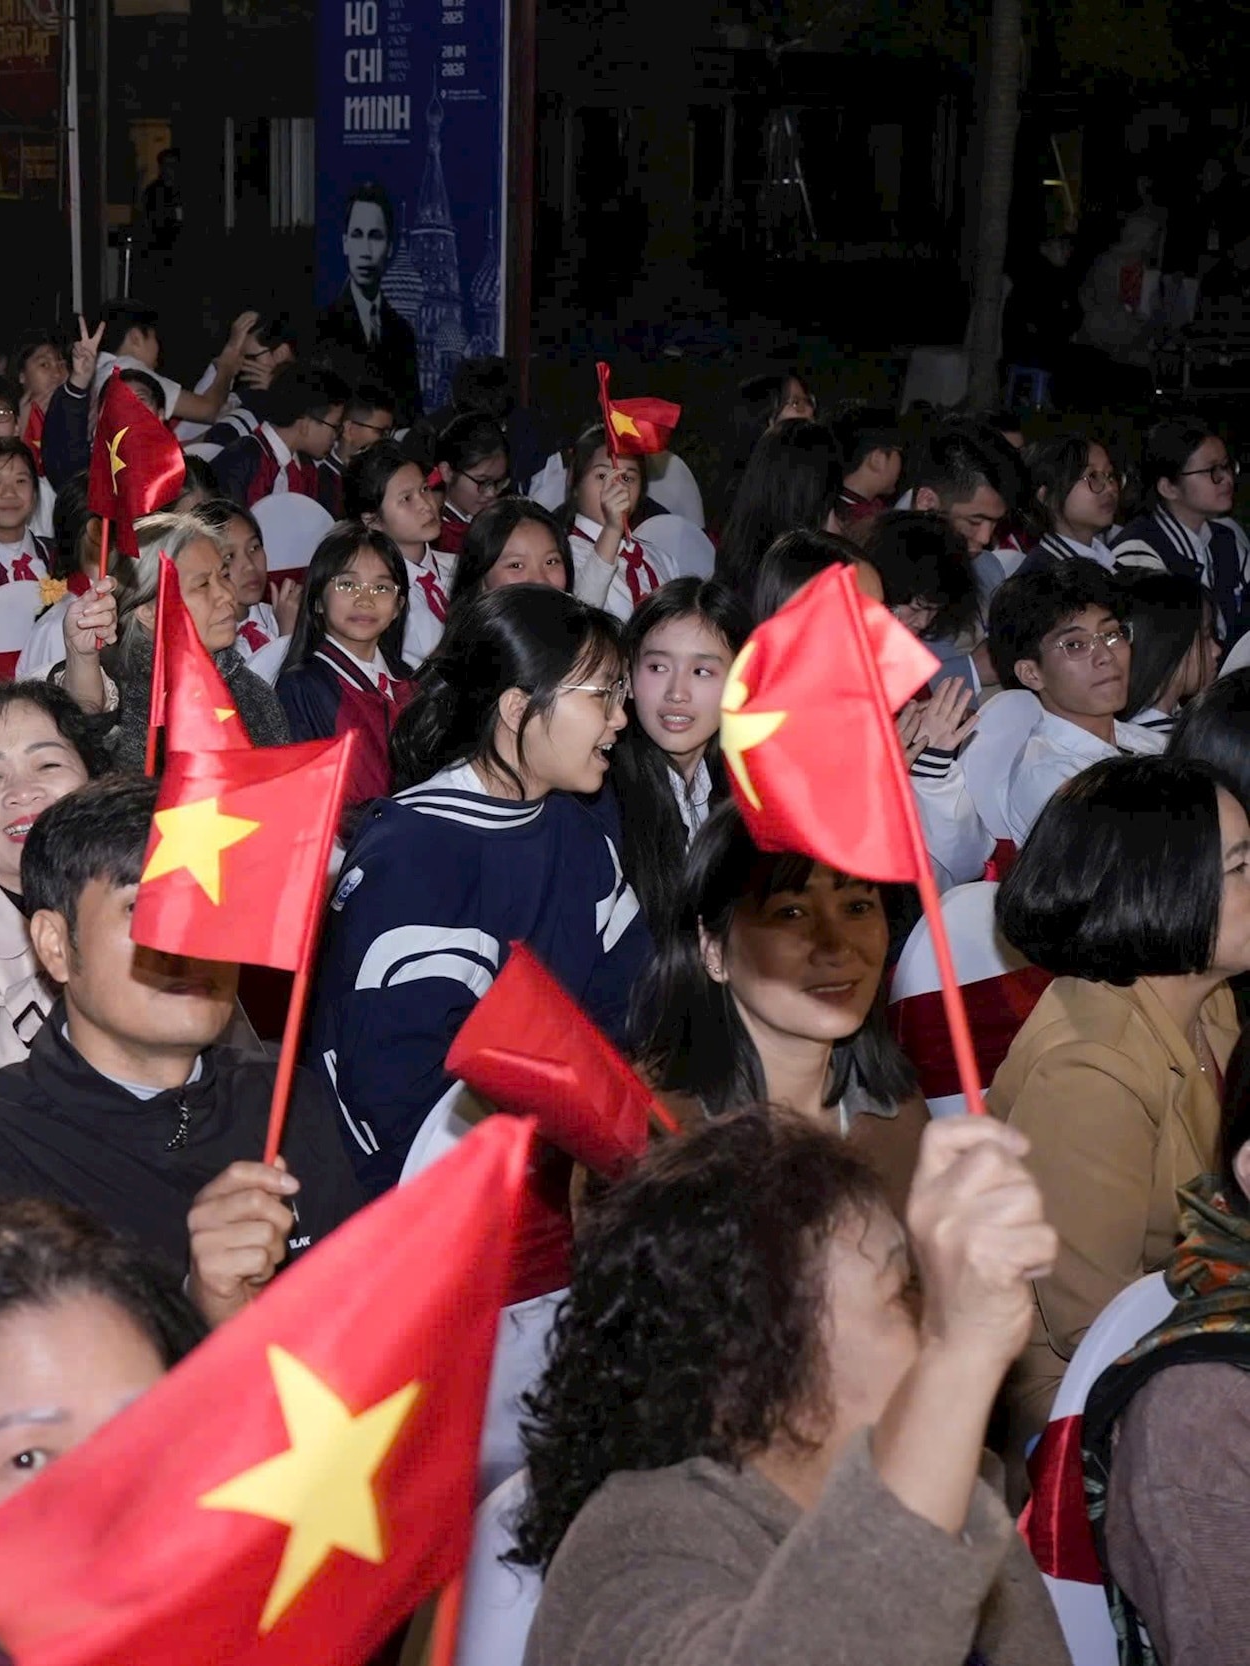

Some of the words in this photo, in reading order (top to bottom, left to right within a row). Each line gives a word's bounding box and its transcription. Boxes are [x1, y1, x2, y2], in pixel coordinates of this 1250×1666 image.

[441, 11, 465, 25] 2025
[441, 62, 466, 77] 2026
[344, 94, 411, 131] MINH
